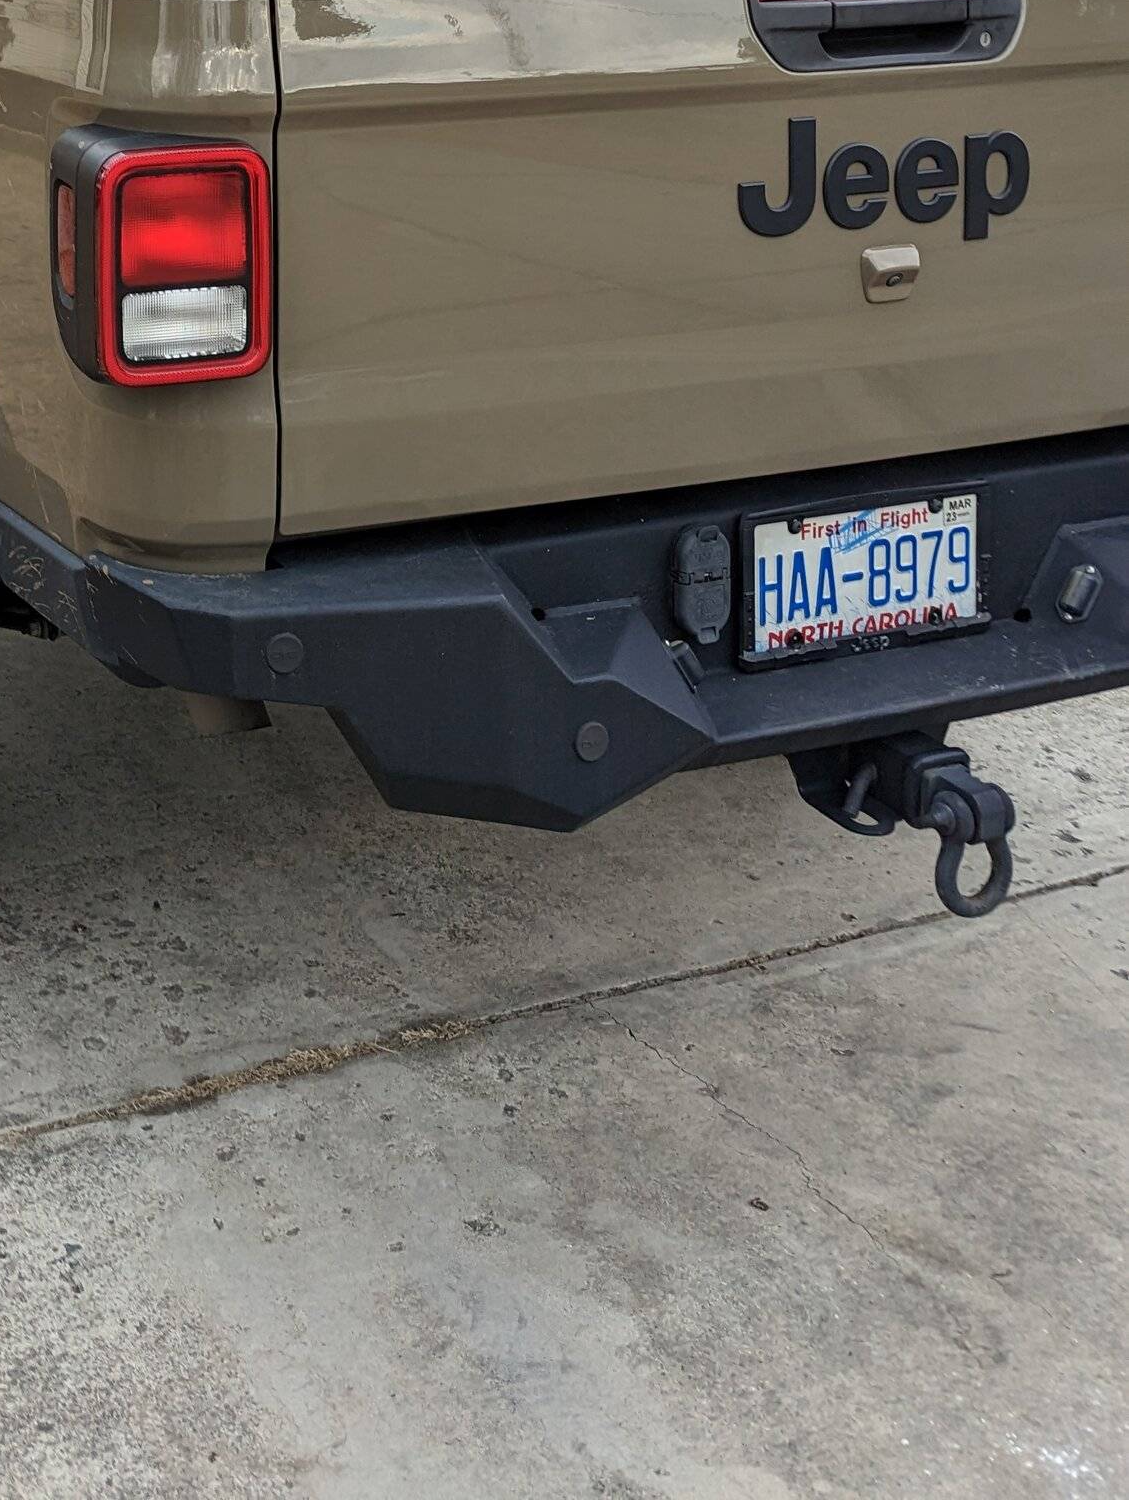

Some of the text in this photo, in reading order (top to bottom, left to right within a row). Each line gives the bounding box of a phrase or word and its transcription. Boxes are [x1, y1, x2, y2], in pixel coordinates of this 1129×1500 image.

[737, 116, 1030, 241] Jeep
[800, 508, 928, 540] First in Flight
[949, 498, 972, 511] MAR
[759, 526, 971, 627] HAA-8979
